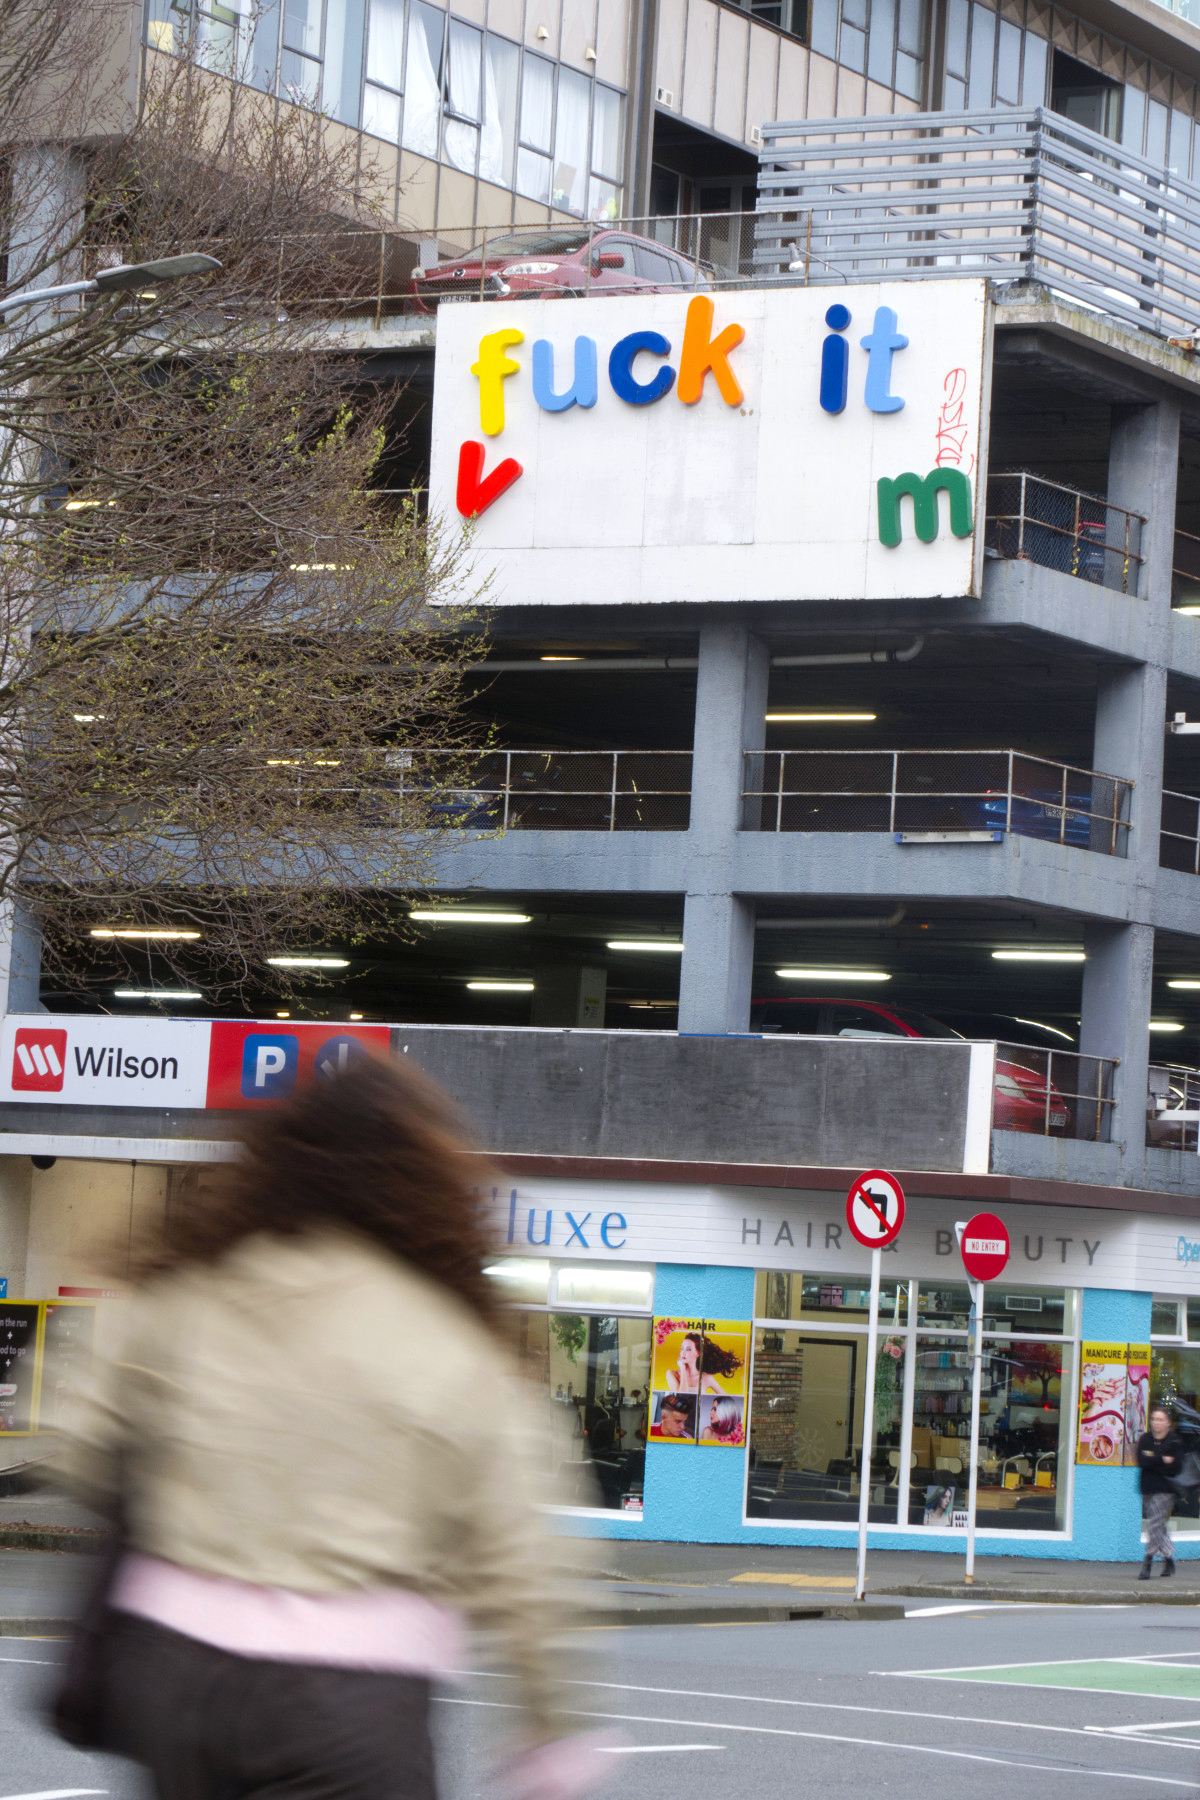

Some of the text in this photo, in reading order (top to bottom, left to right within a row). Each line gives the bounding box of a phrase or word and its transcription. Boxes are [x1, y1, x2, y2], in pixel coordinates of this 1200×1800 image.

[470, 294, 909, 436] fuck it
[456, 439, 524, 519] v
[876, 466, 975, 548] m
[74, 1046, 178, 1079] Wilson
[255, 1046, 286, 1087] P
[471, 1186, 627, 1248] 'luxe
[741, 1218, 842, 1250] HAIR
[935, 1230, 1101, 1266] BUTY
[971, 1241, 1000, 1252] NO ENTRY
[1177, 1236, 1200, 1267] Ope
[5, 1316, 16, 1327] the
[16, 1319, 28, 1328] run
[687, 1321, 716, 1331] HAIR
[0, 1344, 26, 1357] od to go
[1086, 1348, 1122, 1359] MANICURE
